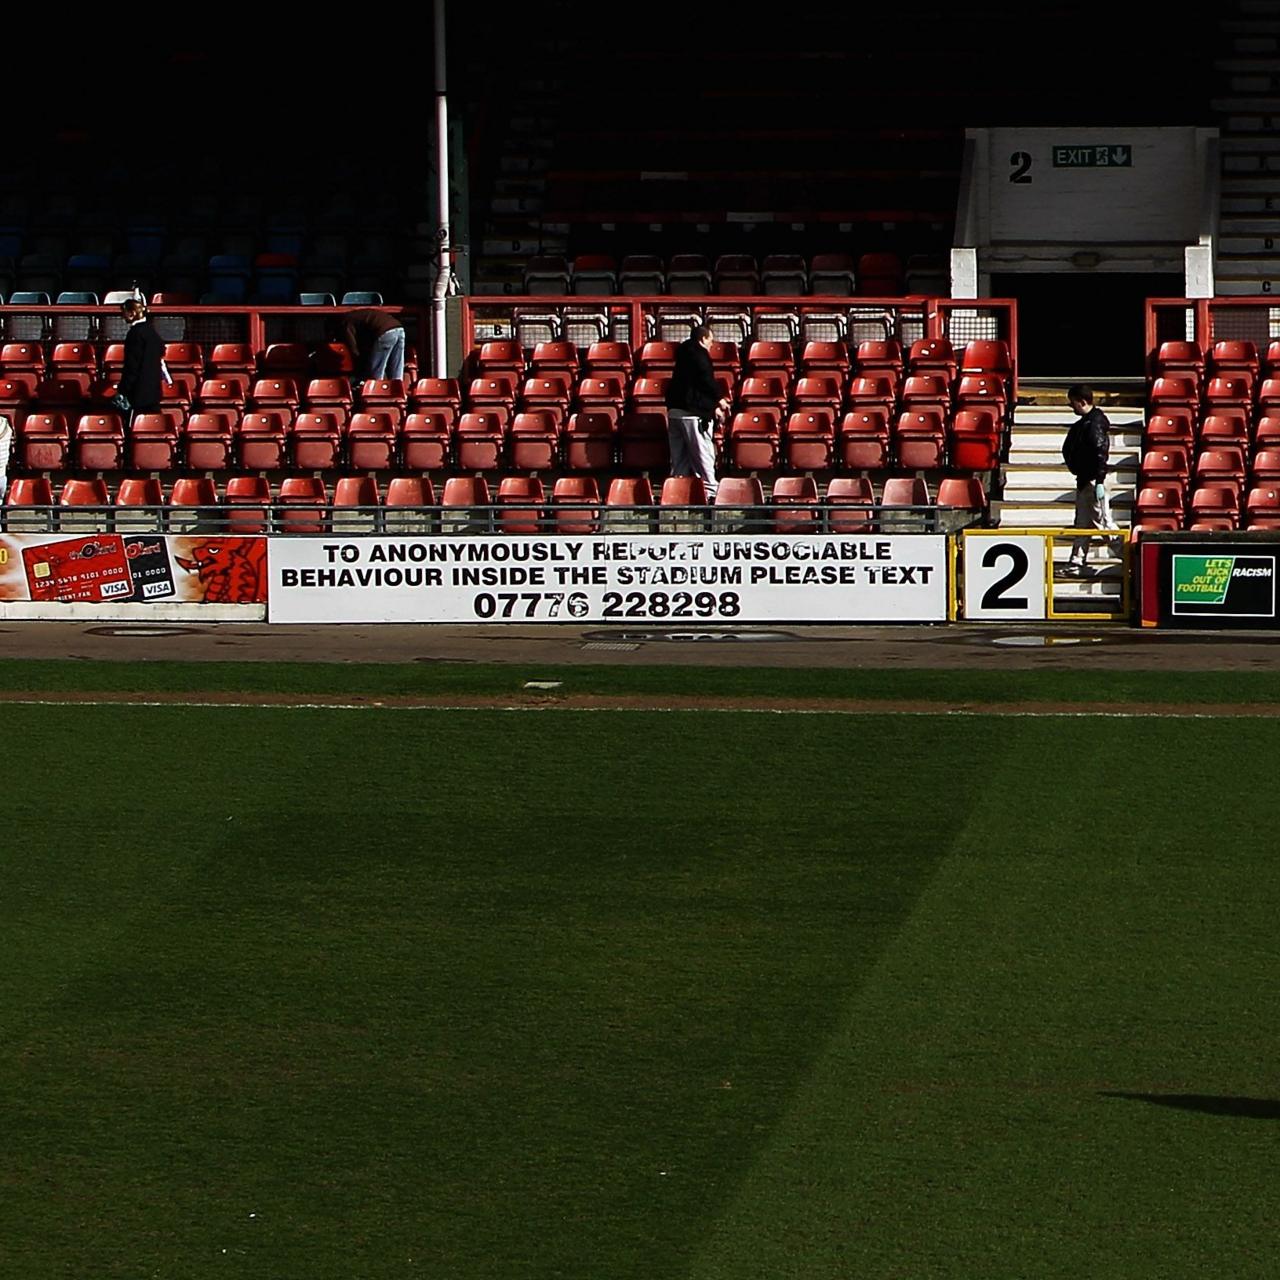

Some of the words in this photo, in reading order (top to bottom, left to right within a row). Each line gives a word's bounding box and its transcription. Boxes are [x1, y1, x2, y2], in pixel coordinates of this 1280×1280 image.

[1056, 149, 1093, 165] EXIT
[1009, 151, 1033, 184] 2
[1262, 280, 1271, 293] C
[493, 323, 503, 337] B
[323, 544, 360, 562] TO
[368, 543, 583, 562] ANONYMOUSLY
[712, 542, 892, 561] UNSOCIABLE
[1205, 559, 1232, 568] LET'S
[281, 568, 443, 587] BEHAVIOUR
[452, 567, 546, 586] INSIDE
[553, 567, 608, 585] THE
[617, 566, 742, 585] STADIUM
[750, 566, 855, 585] PLEASE
[864, 566, 934, 585] TEXT
[980, 543, 1029, 610] 2
[1206, 567, 1230, 576] KICK
[1232, 568, 1273, 578] RACISM
[1192, 575, 1213, 584] OUT
[1214, 575, 1228, 584] OF
[103, 583, 128, 594] VISA
[145, 583, 170, 594] VISA
[1177, 583, 1224, 593] FOOTBALL
[473, 592, 590, 618] 07776
[602, 591, 741, 617] 228298
